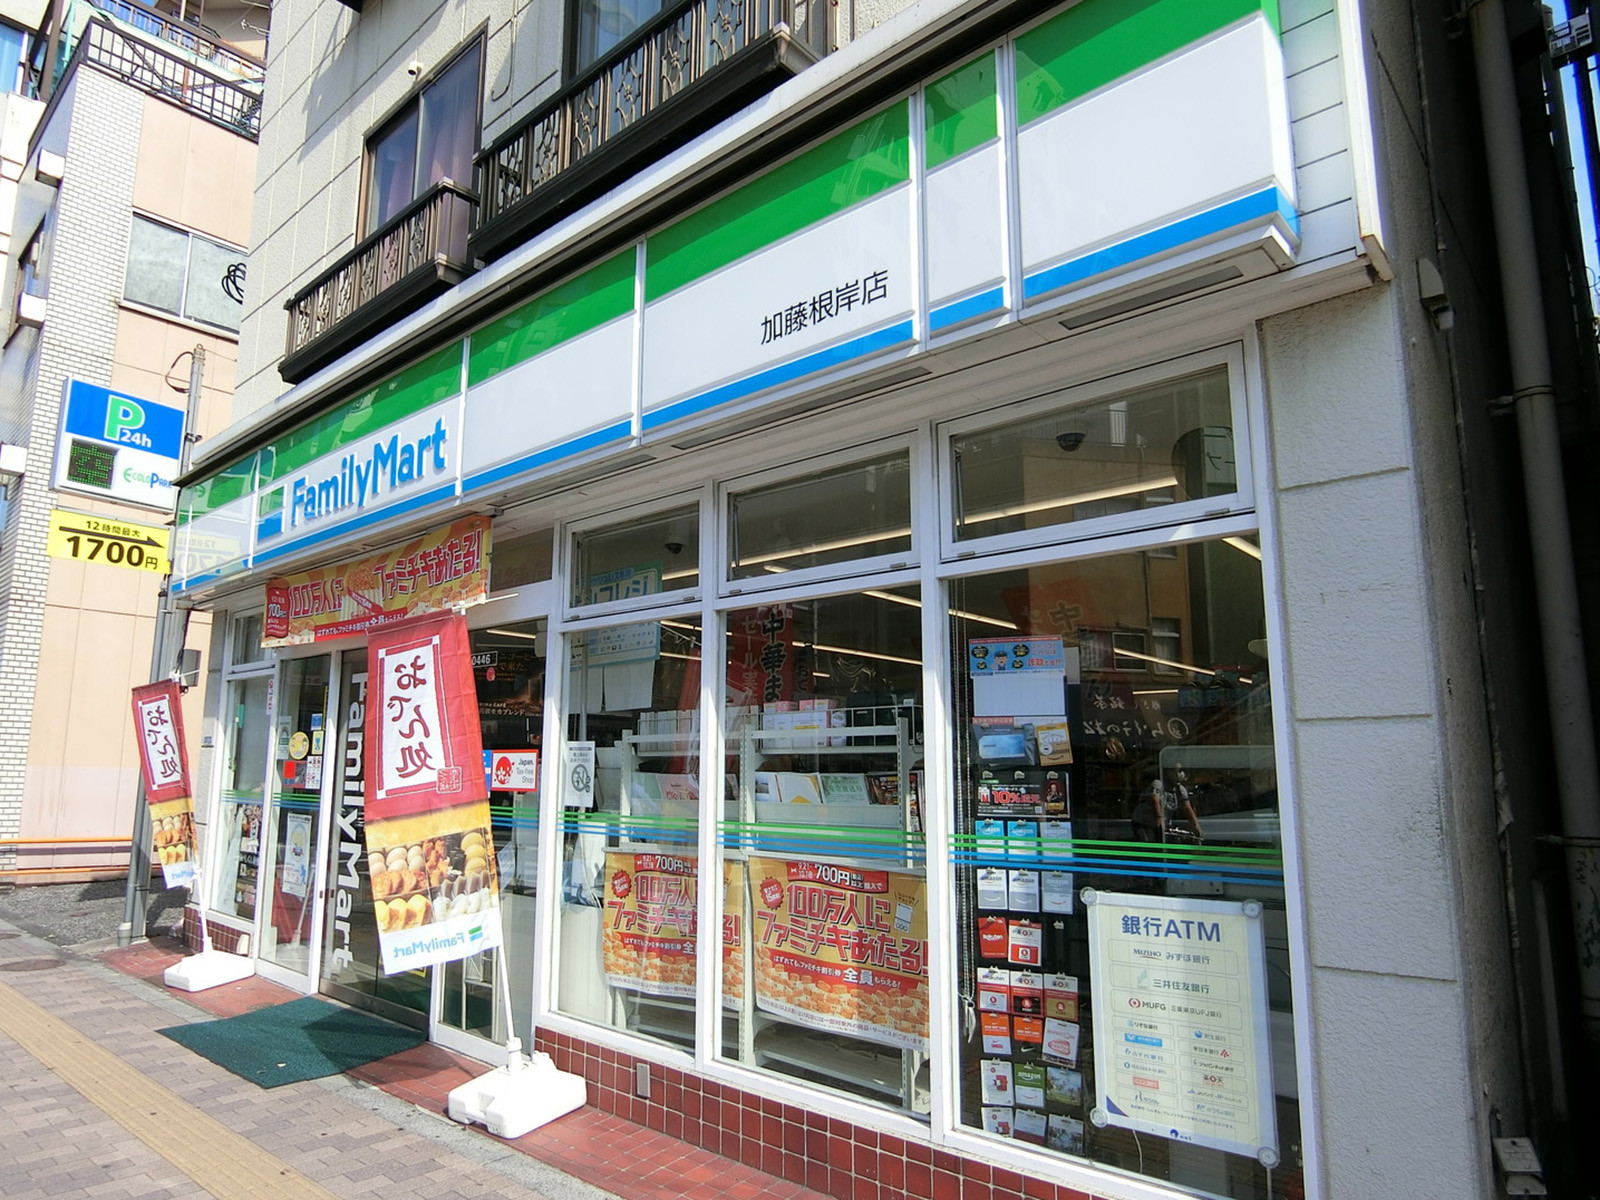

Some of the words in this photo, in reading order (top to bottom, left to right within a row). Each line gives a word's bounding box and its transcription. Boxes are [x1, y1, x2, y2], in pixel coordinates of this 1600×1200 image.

[760, 269, 889, 345] 加藤根岸店
[103, 394, 145, 441] P
[121, 429, 152, 448] 24h
[291, 416, 448, 527] FamilyMart
[86, 520, 141, 538] 12時間最大
[66, 535, 158, 570] 1700円
[373, 529, 482, 601] ファミチキあたる!
[333, 672, 369, 969] FamilyMart
[655, 855, 684, 872] 700円
[815, 864, 850, 886] 700円
[633, 872, 697, 907] 100万人
[786, 881, 892, 932] 100万人に
[757, 908, 929, 976] ファミチキあたる!
[1121, 914, 1221, 943] 銀行ATM
[1133, 948, 1162, 957] MIZUHO
[1165, 952, 1210, 964] みずほ銀行
[843, 967, 874, 986] 全員
[874, 976, 901, 989] もらえる!
[1153, 979, 1210, 994] 三井住友銀行
[1142, 1000, 1166, 1010] MUFG
[1017, 1071, 1041, 1081] amazon
